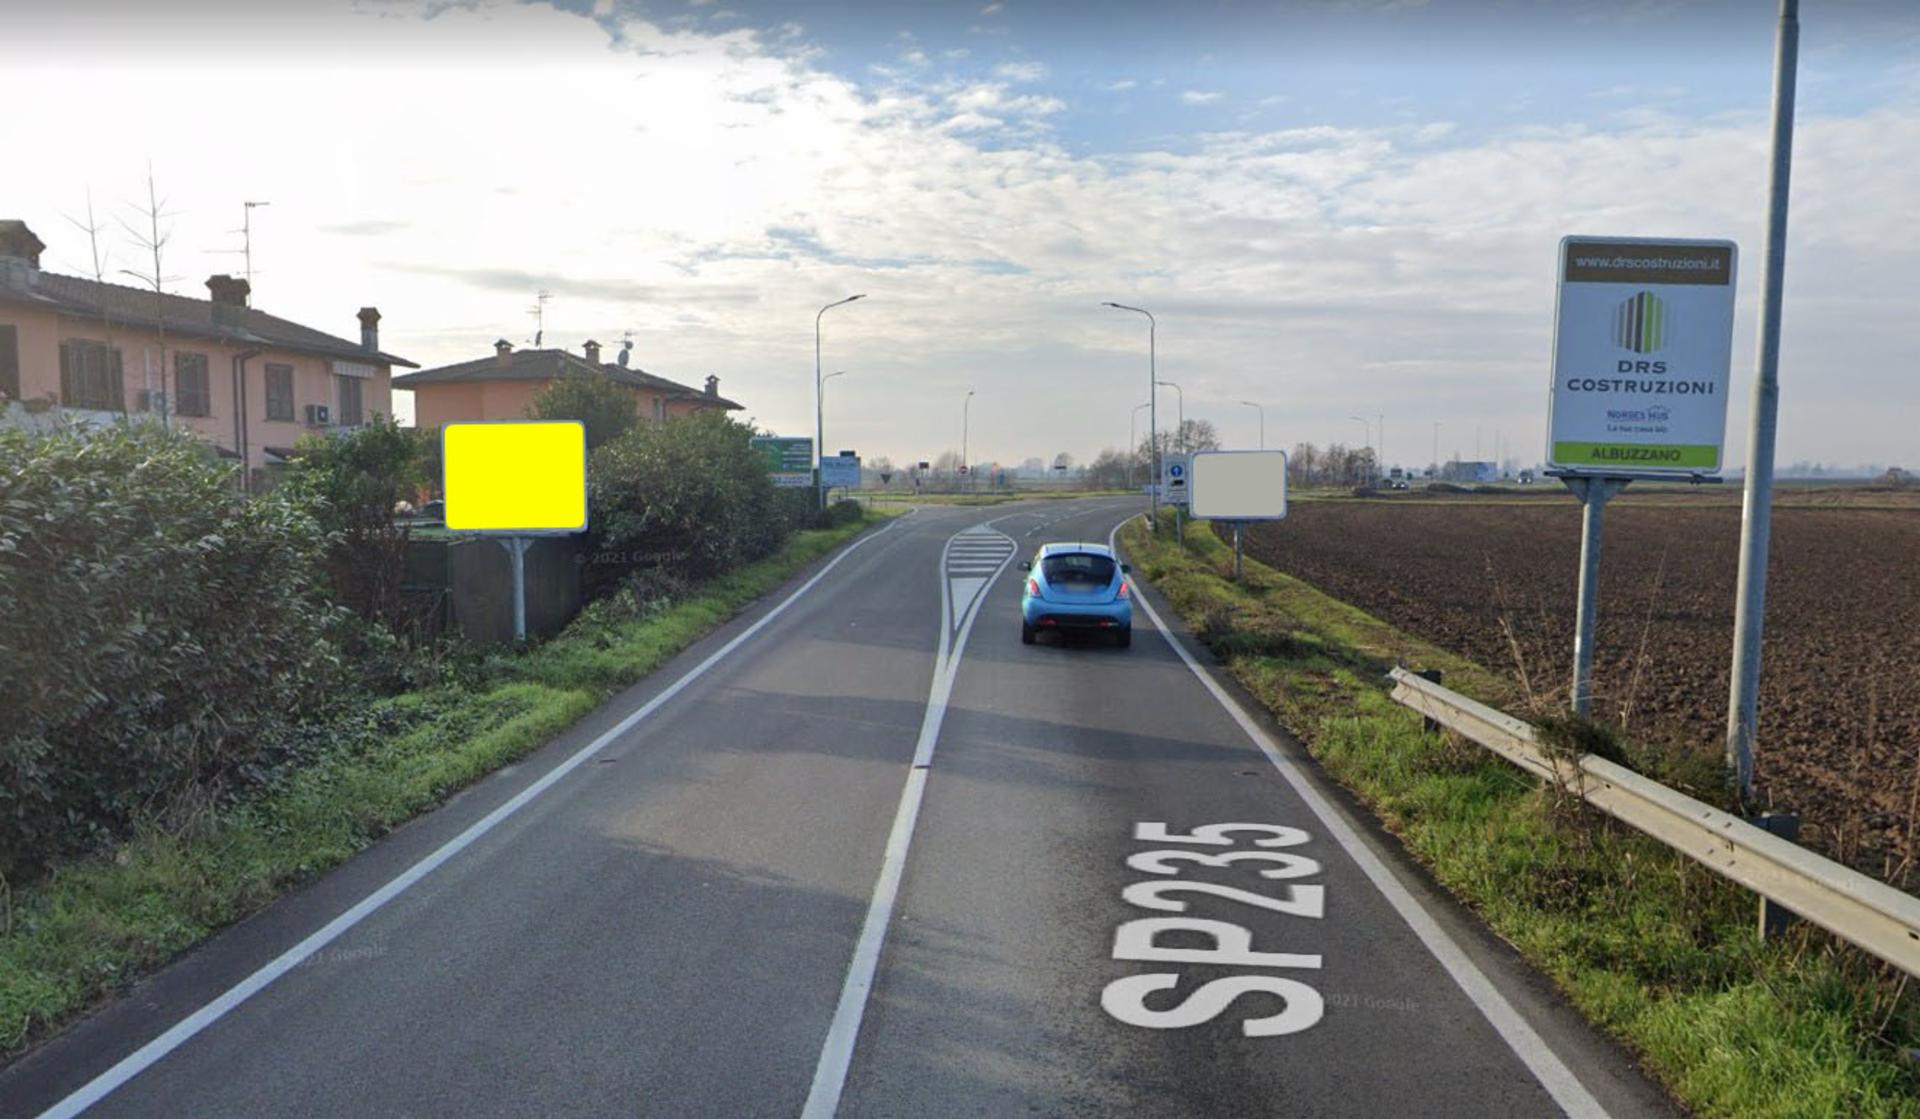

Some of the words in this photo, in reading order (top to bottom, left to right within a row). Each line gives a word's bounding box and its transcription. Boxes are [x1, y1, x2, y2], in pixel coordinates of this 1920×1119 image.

[1575, 255, 1721, 271] www.drscostruzioni.it
[1618, 360, 1666, 374] DRS
[1567, 379, 1714, 395] COSTRUZIONI
[1591, 447, 1681, 462] ALBUZZANO
